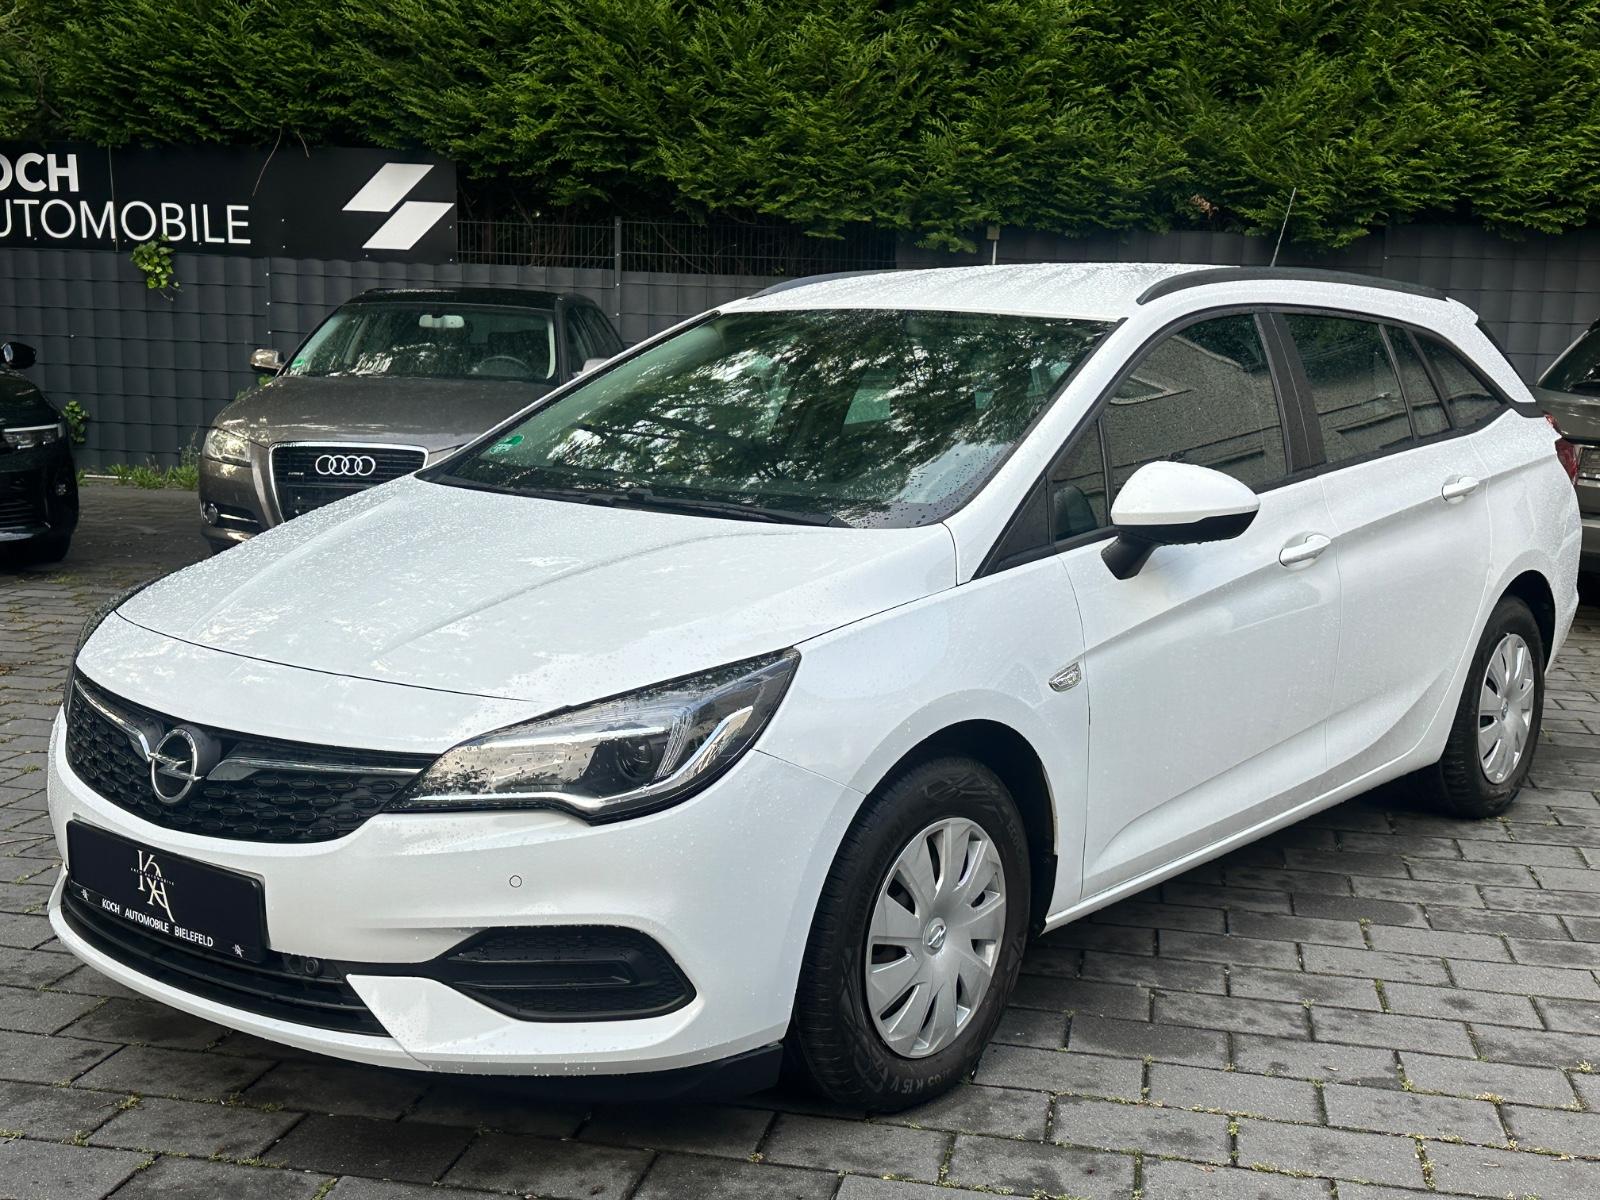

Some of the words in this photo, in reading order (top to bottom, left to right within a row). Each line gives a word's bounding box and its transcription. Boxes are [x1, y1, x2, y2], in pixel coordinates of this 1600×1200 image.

[102, 898, 120, 914] KOCH
[124, 908, 170, 933] AUTOMOBILE
[174, 925, 214, 947] BIELEFELD
